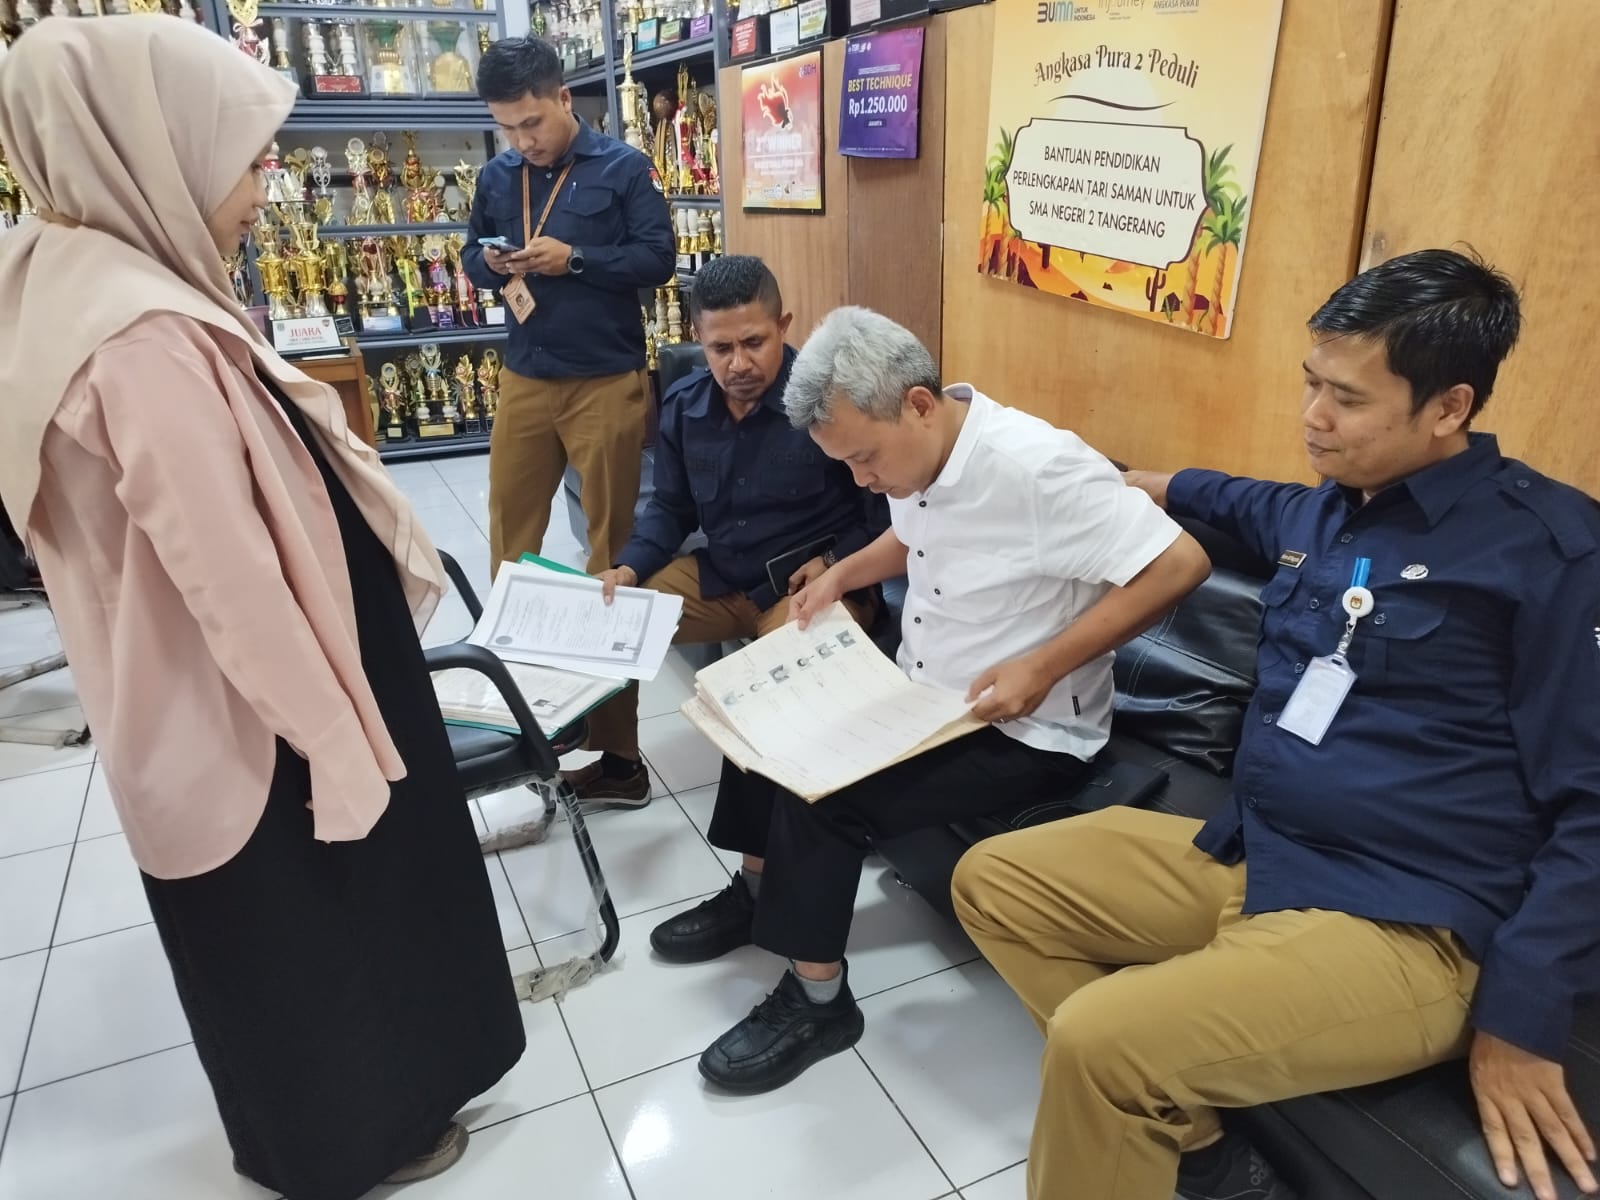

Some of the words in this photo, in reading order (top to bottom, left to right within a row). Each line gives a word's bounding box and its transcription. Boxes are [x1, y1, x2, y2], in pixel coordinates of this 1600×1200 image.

[1033, 52, 1091, 87] Angkasa
[1095, 45, 1131, 69] Pura
[1134, 53, 1143, 70] 2
[1148, 48, 1200, 88] Peduli
[848, 78, 864, 92] BEST
[866, 74, 912, 90] TECHNIQUE
[849, 95, 907, 118] Rp1.250.000
[1044, 145, 1091, 165] BANTUAN
[1094, 151, 1161, 173] PENDIDIKAN
[1013, 171, 1084, 194] PERLENGKAPAN
[1087, 179, 1108, 198] TARI
[1111, 183, 1151, 204] SAMAN
[1155, 189, 1197, 211] UNTUK
[1029, 201, 1048, 217] SMA
[1051, 204, 1085, 224] NEGERI
[1088, 210, 1094, 226] 2
[1098, 212, 1165, 238] TANGERANG
[290, 327, 322, 337] JUARA
